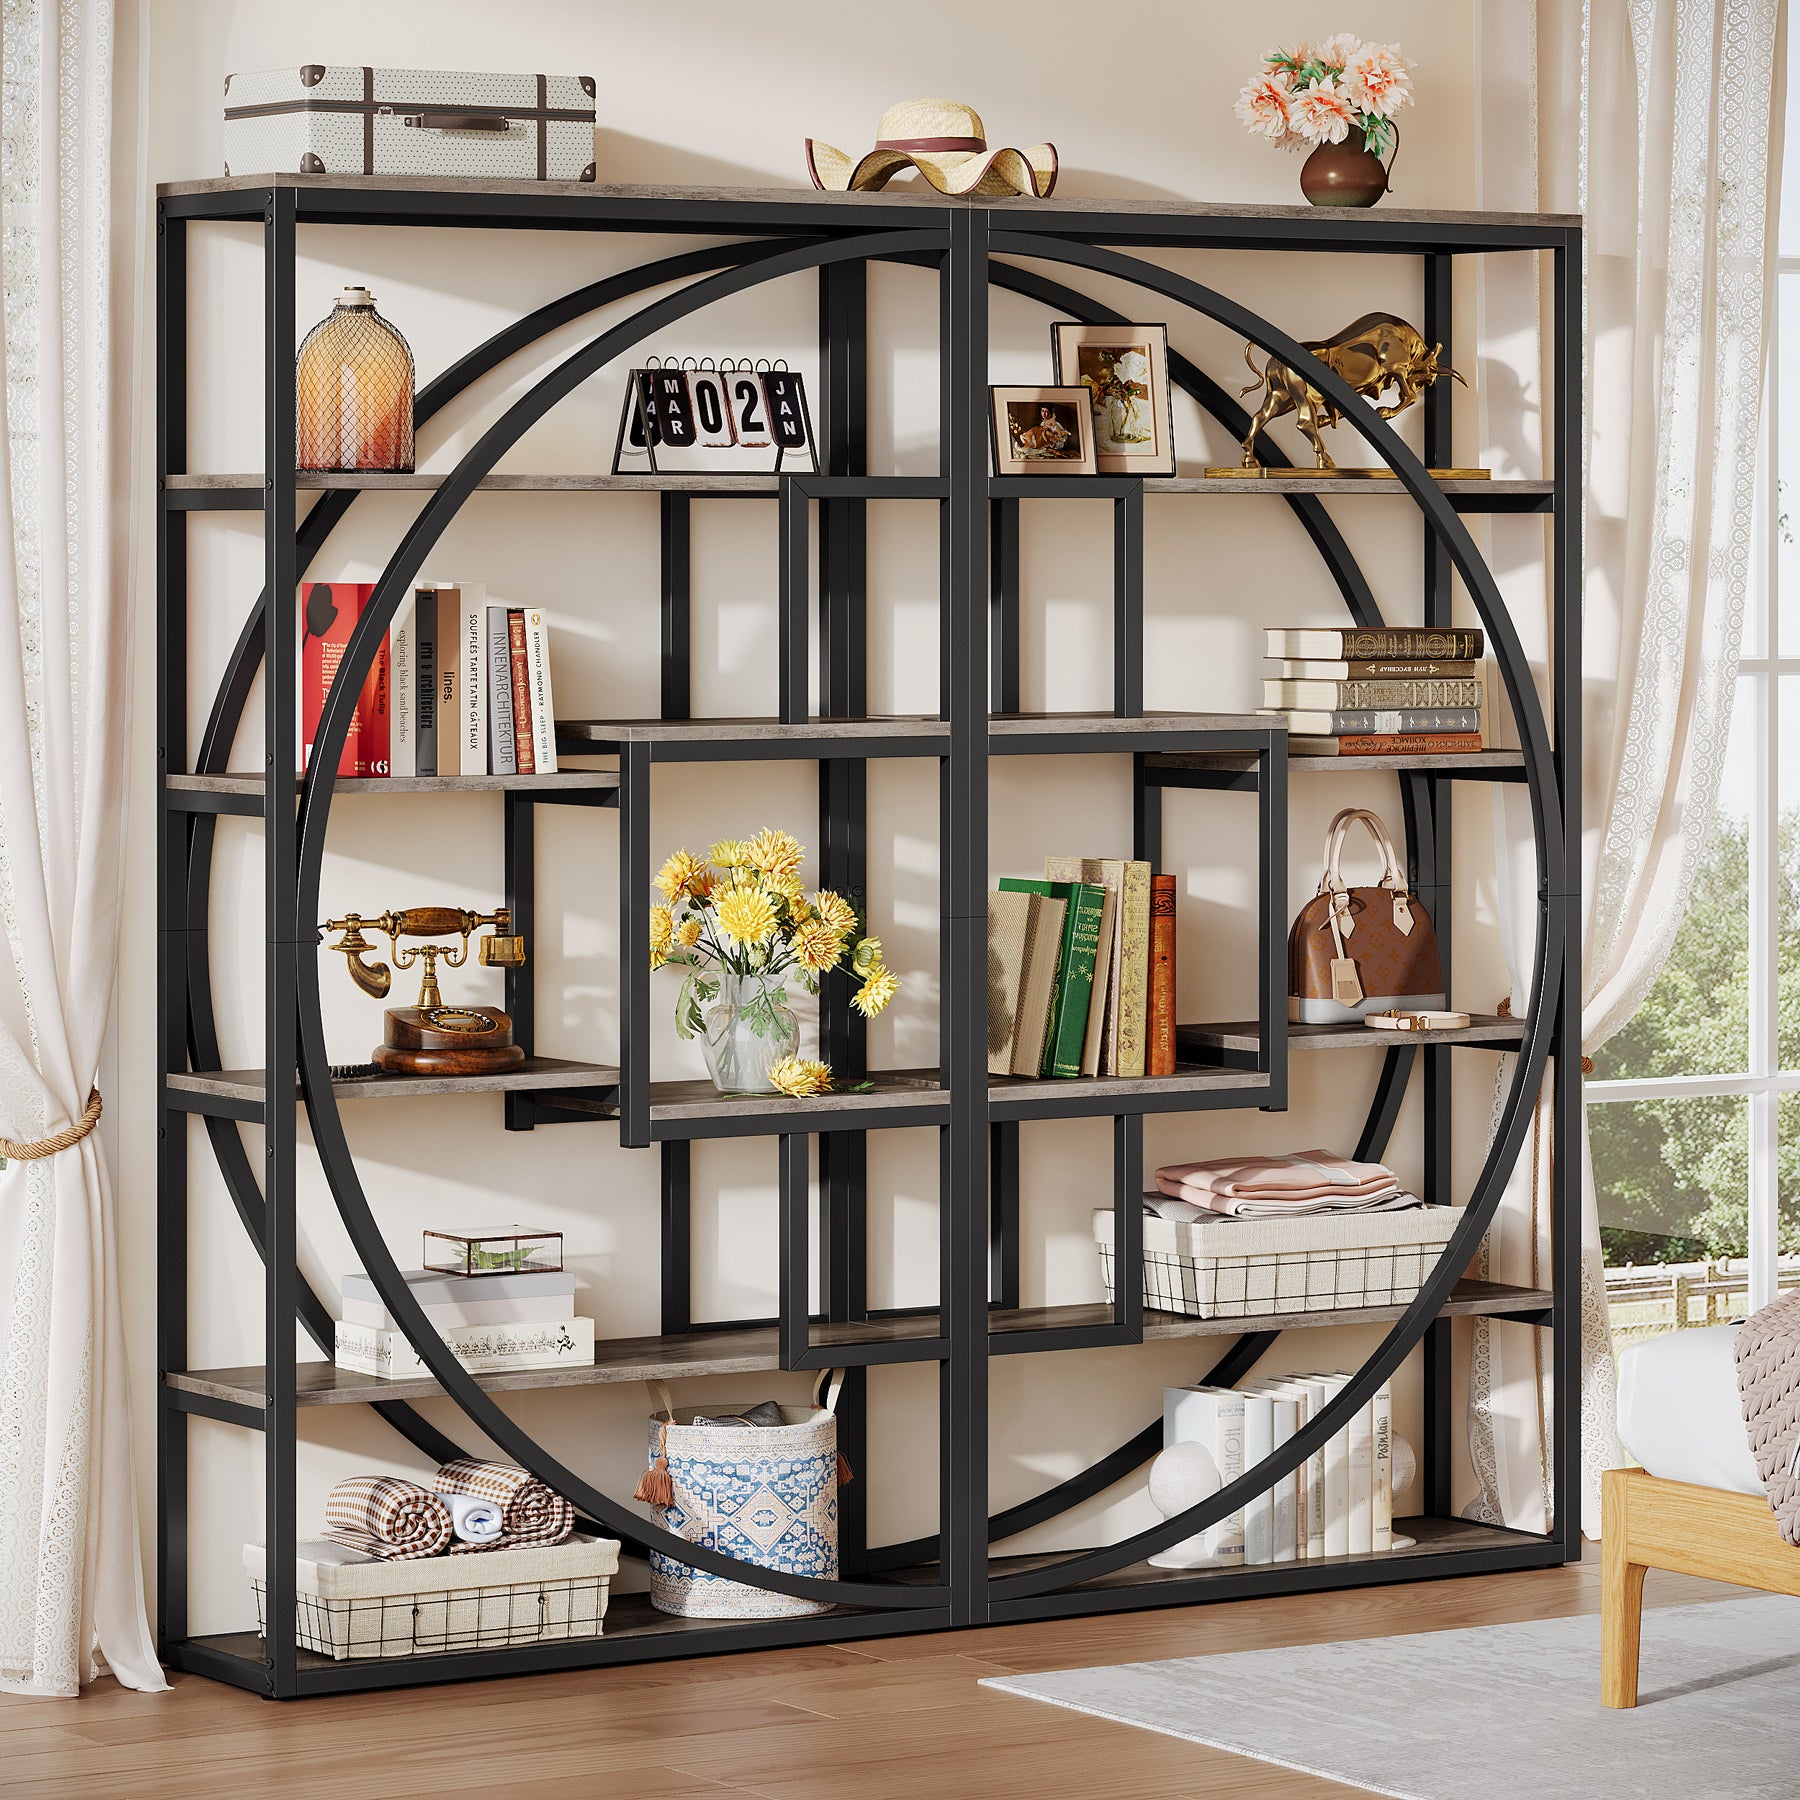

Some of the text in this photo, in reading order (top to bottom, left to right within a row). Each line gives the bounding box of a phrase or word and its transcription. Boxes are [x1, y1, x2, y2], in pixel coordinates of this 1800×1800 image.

[663, 379, 684, 435] MAR
[775, 381, 797, 435] JAN
[420, 641, 434, 660] arts
[533, 631, 545, 706] RAYMOND CHANDLER
[396, 630, 408, 743] exploring black sand beaches
[420, 674, 435, 729] architecture
[443, 671, 455, 704] lines.
[469, 614, 480, 750] SOUFFLÉS TARTE TATIN GÂTEAUX
[493, 632, 513, 764] INNENARCHITEKTUR
[539, 715, 547, 735] SLEEP
[1224, 1428, 1241, 1480] ОНДОН
